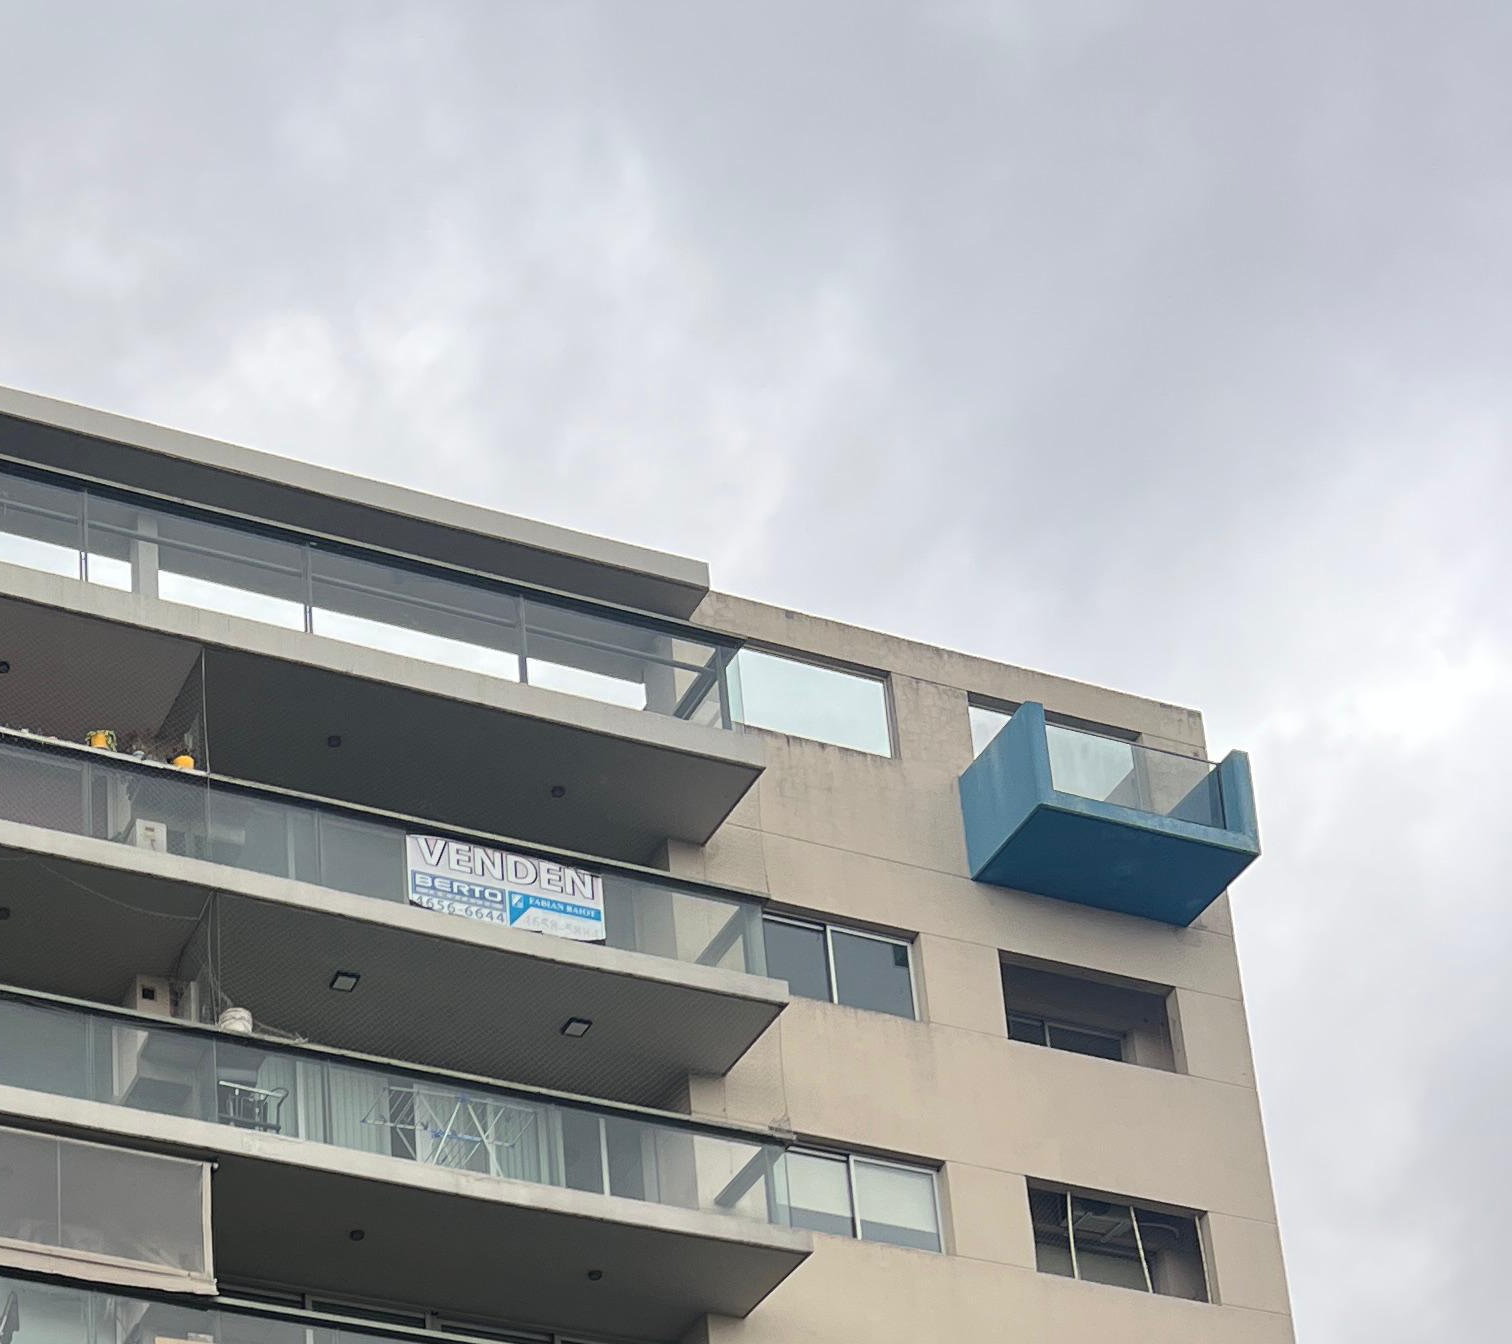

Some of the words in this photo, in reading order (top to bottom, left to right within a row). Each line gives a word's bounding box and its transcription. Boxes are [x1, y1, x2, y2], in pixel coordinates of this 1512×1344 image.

[415, 836, 595, 900] VENDEN
[415, 873, 502, 902] BERTO
[416, 895, 504, 923] 4656-6644
